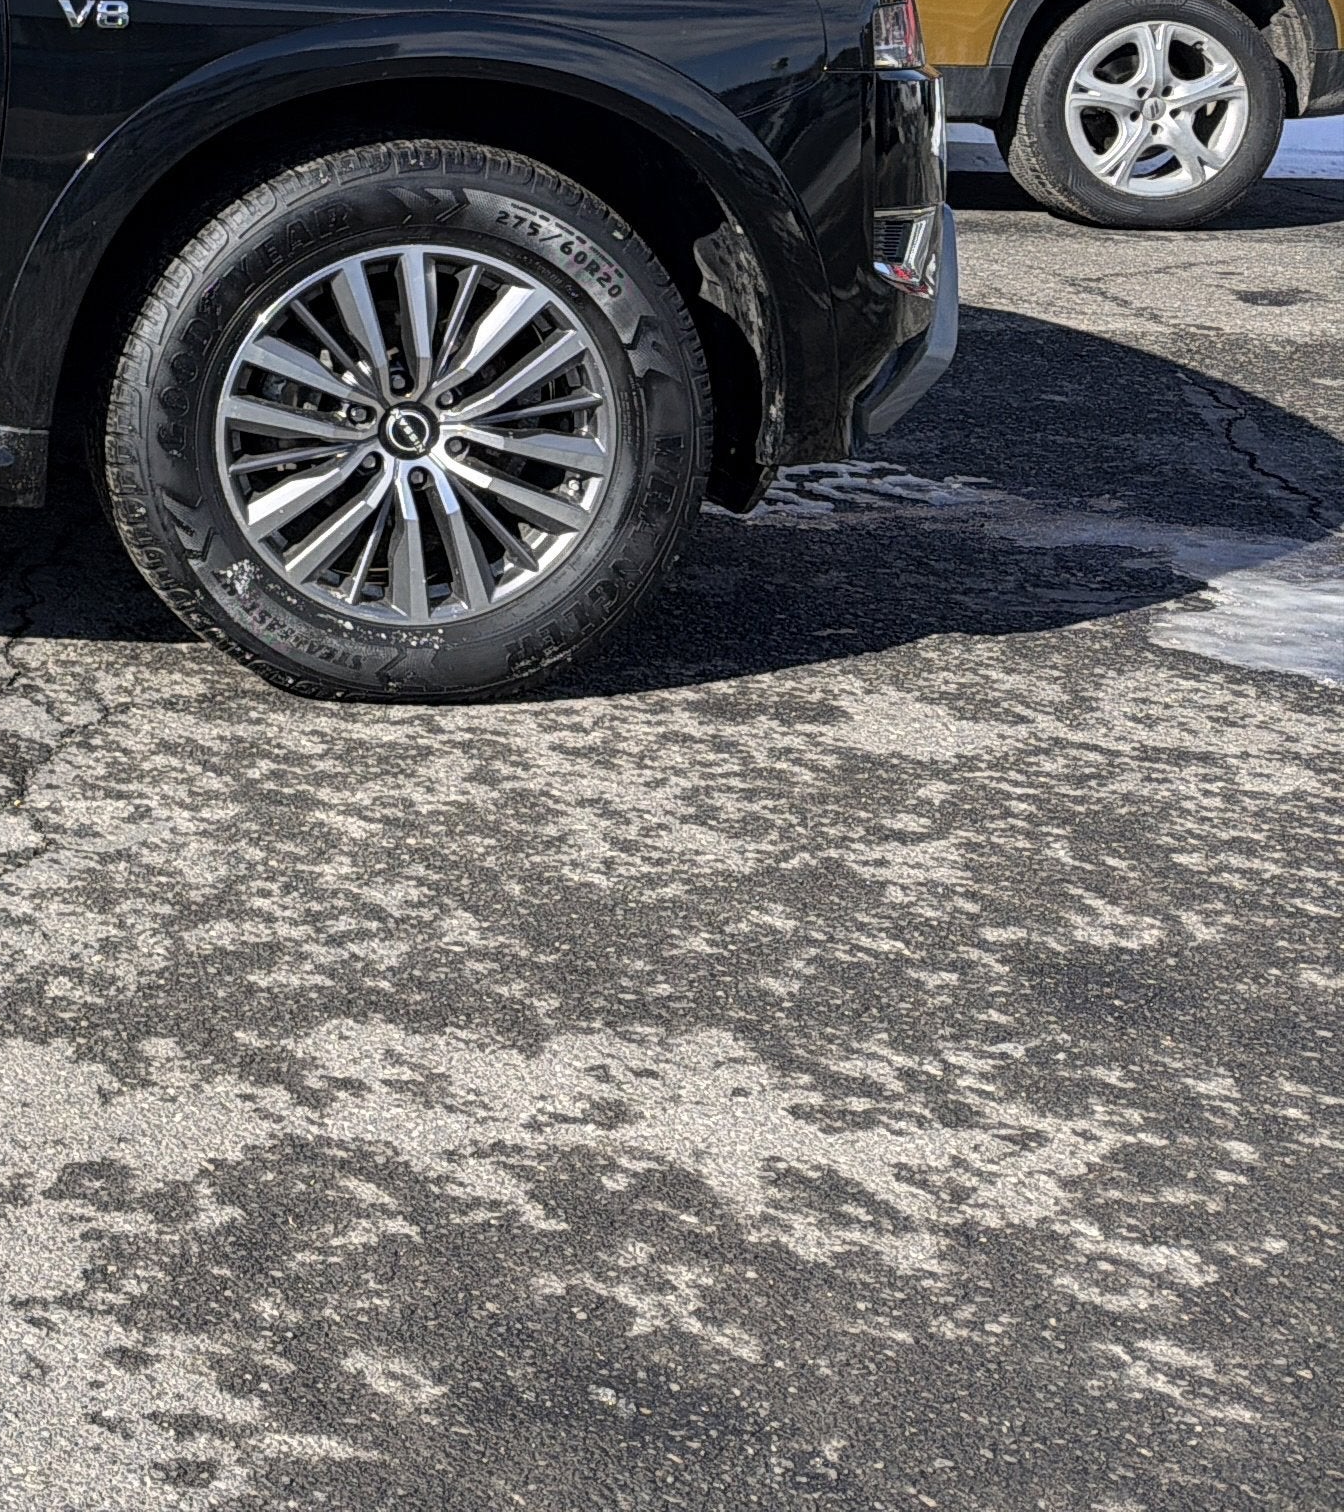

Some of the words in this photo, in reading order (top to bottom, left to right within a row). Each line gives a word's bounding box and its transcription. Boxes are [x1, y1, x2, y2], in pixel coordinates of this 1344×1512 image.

[58, 0, 130, 29] V8
[495, 210, 623, 299] 275/60R20
[157, 200, 354, 457] GOODYEAR
[391, 408, 426, 454] NISSAN
